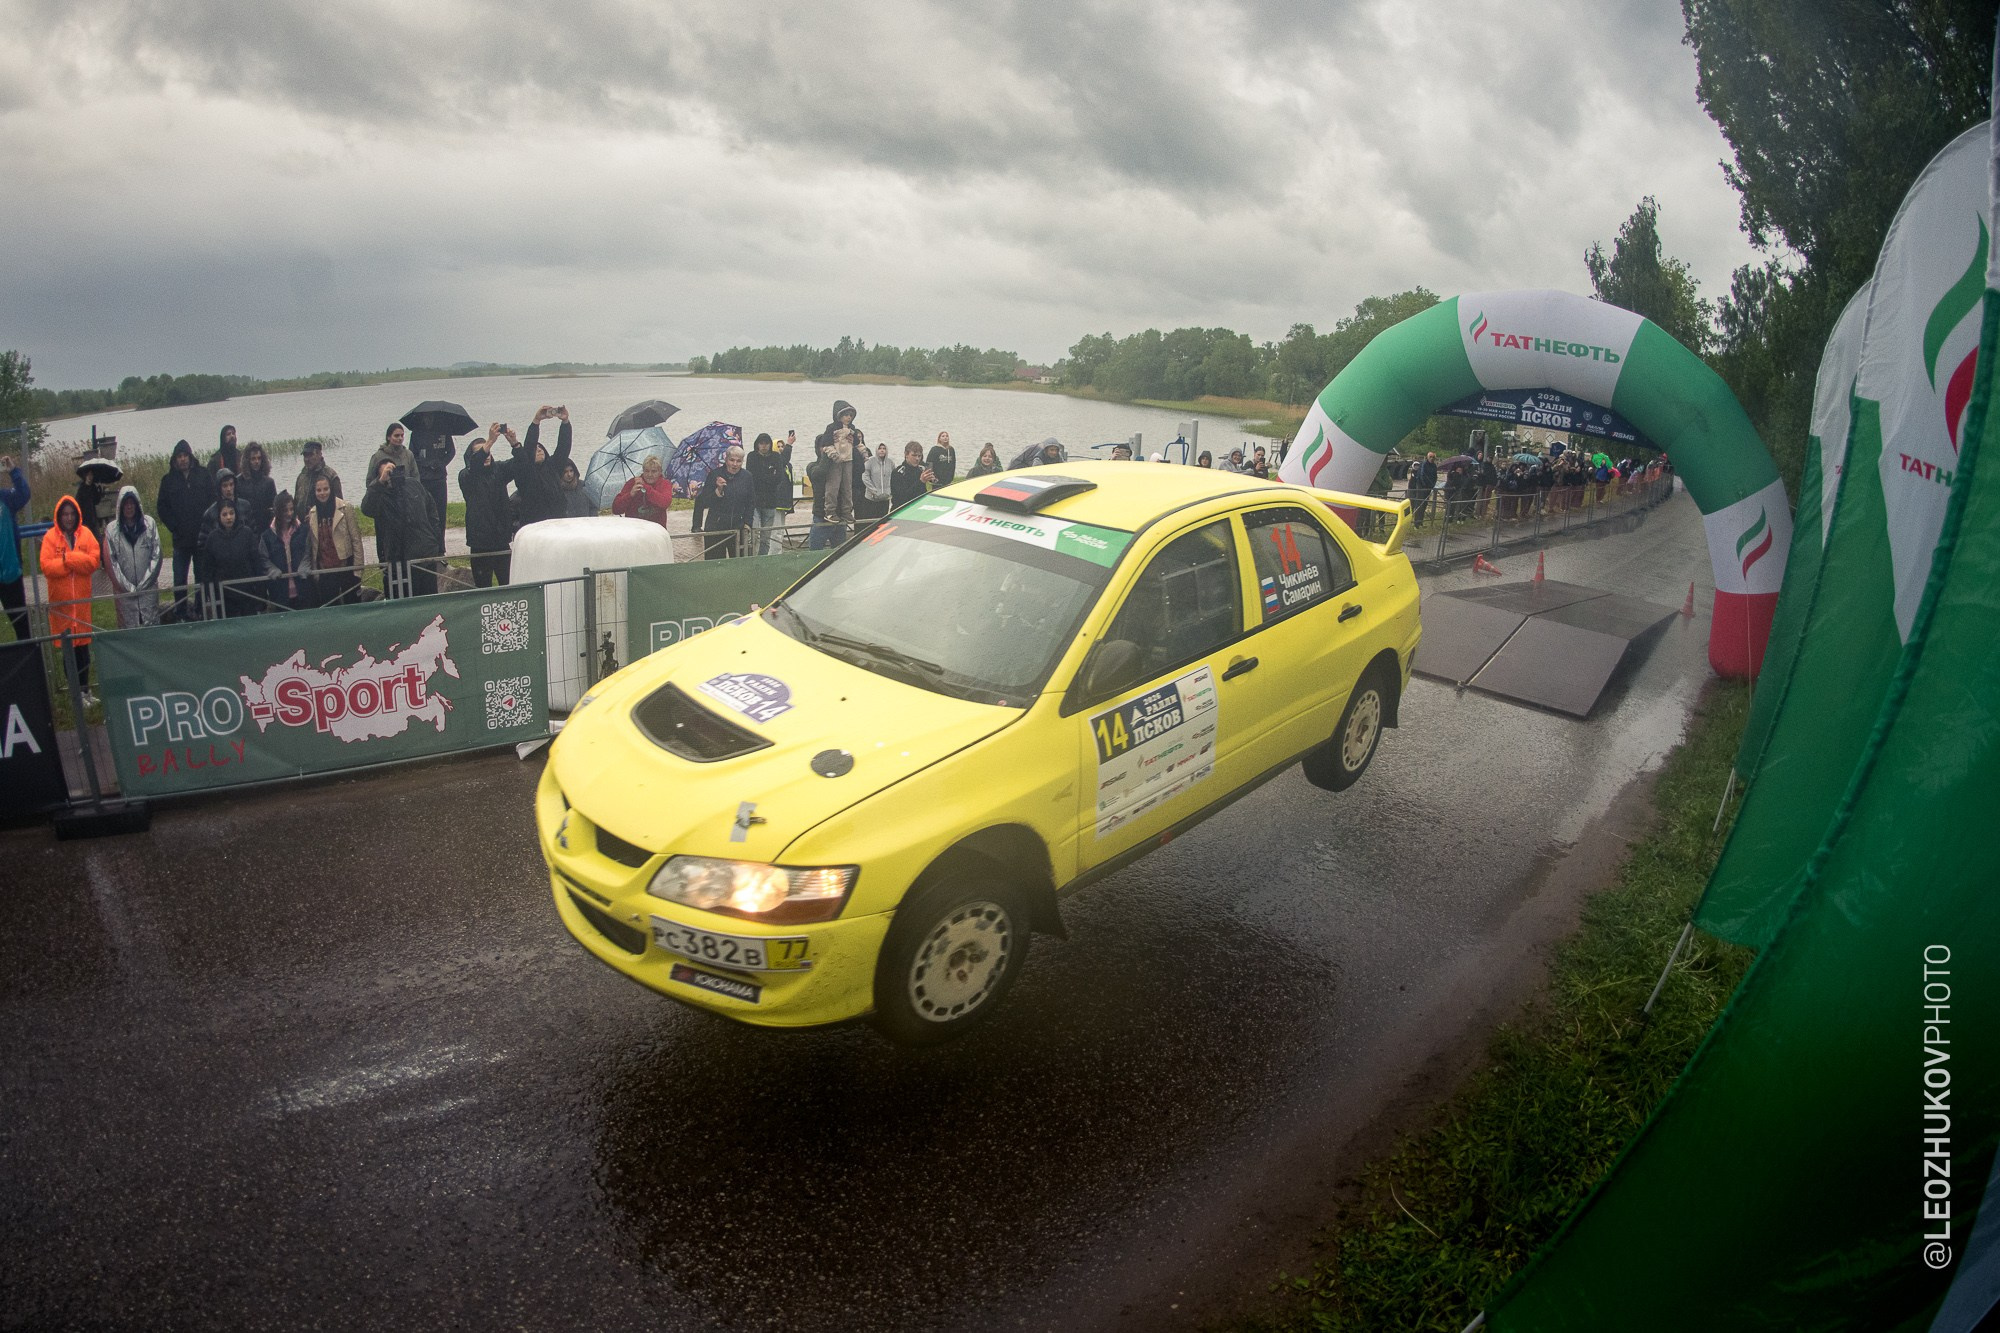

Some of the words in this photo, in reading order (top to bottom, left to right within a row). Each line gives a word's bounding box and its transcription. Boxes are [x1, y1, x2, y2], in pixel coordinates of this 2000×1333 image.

[1491, 332, 1620, 364] ТАТНЕФТЬ
[1538, 392, 1560, 402] 2026
[1539, 401, 1573, 413] РАЛЛИ
[1521, 409, 1571, 429] ПСКОВ
[966, 513, 1046, 538] ТАТНЕФТЬ
[1278, 563, 1320, 590] Чикинёв
[1282, 580, 1322, 607] Самарин
[715, 680, 764, 706] ПСКОВ
[1145, 693, 1179, 717] РАЛЛИ
[748, 700, 790, 720] 14
[1097, 712, 1129, 758] 14
[1131, 708, 1182, 746] ПСКОВ
[136, 738, 247, 777] RALLY
[777, 940, 809, 959] 77
